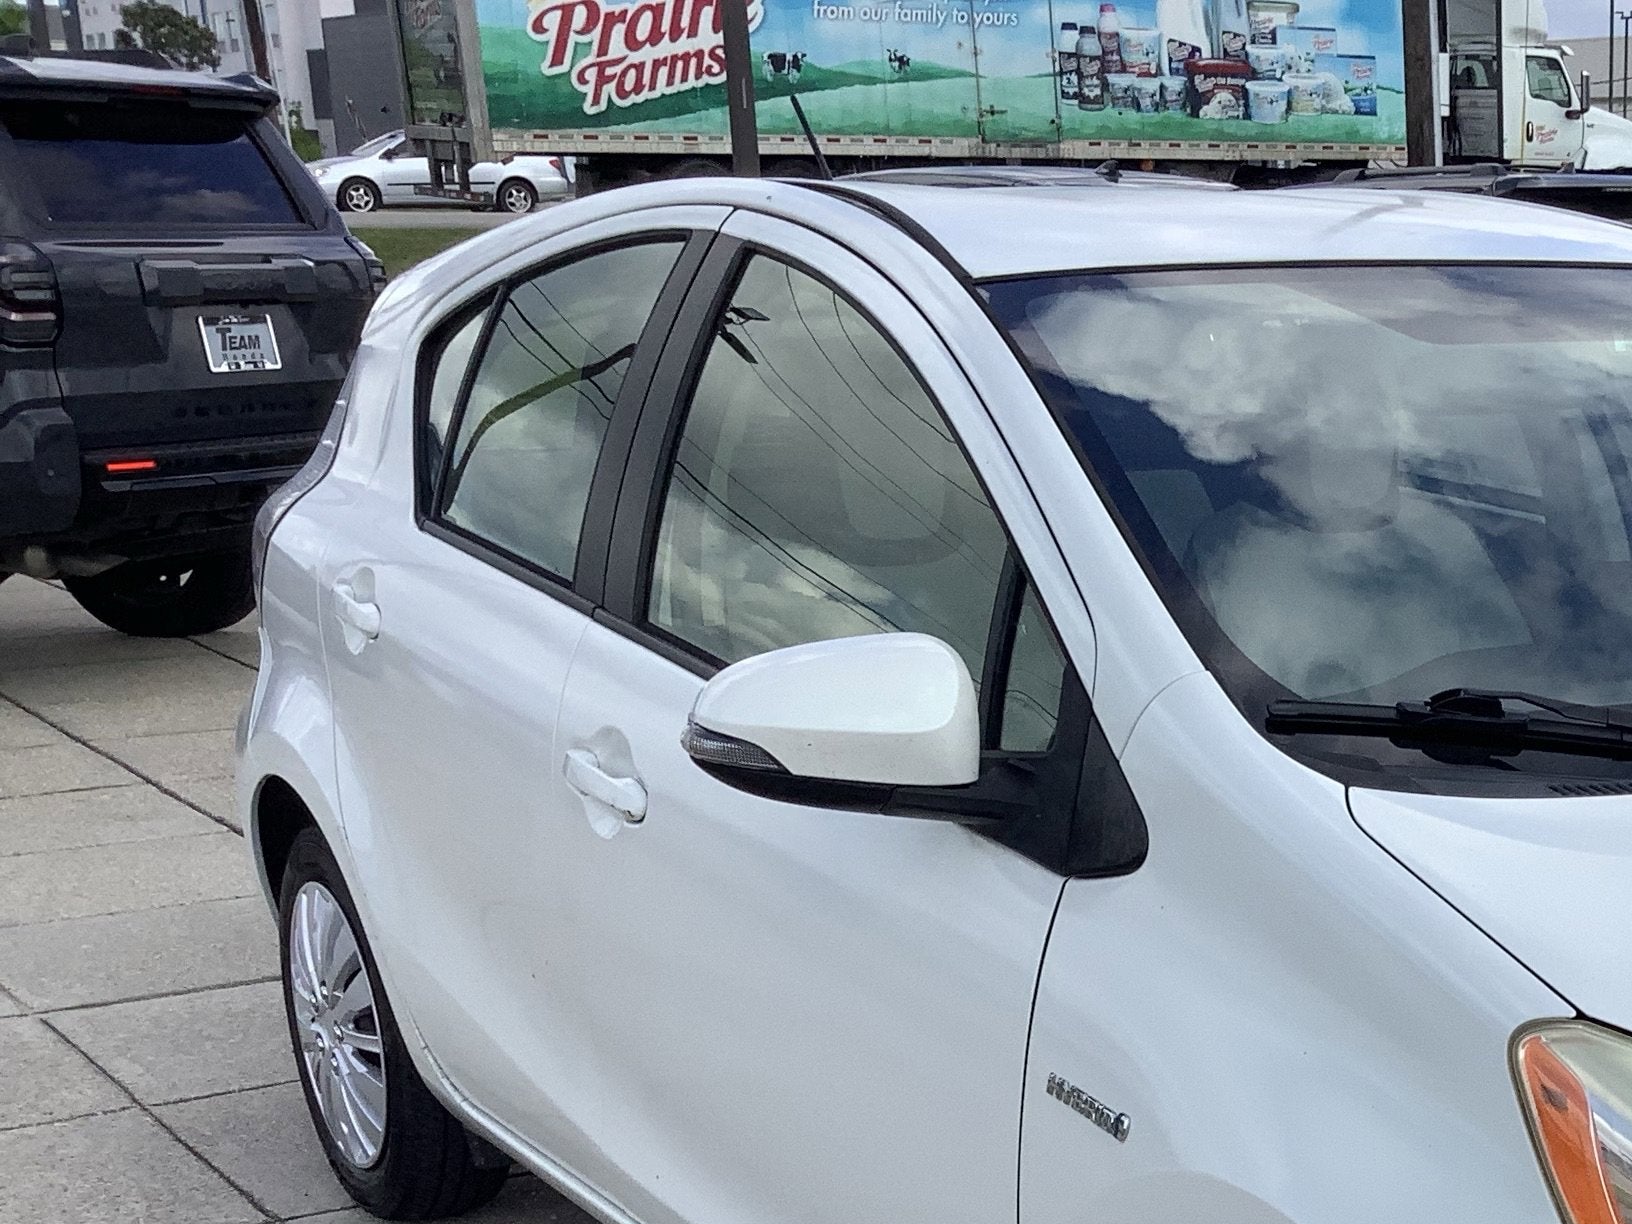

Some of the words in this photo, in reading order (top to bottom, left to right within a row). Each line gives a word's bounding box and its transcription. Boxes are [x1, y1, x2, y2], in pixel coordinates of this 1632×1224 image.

[532, 0, 757, 69] Prairi
[813, 3, 854, 20] from
[860, 7, 888, 21] our
[895, 1, 947, 28] family
[952, 7, 968, 23] to
[973, 11, 1018, 28] yours
[577, 44, 728, 108] Farms
[216, 327, 261, 351] TEAM
